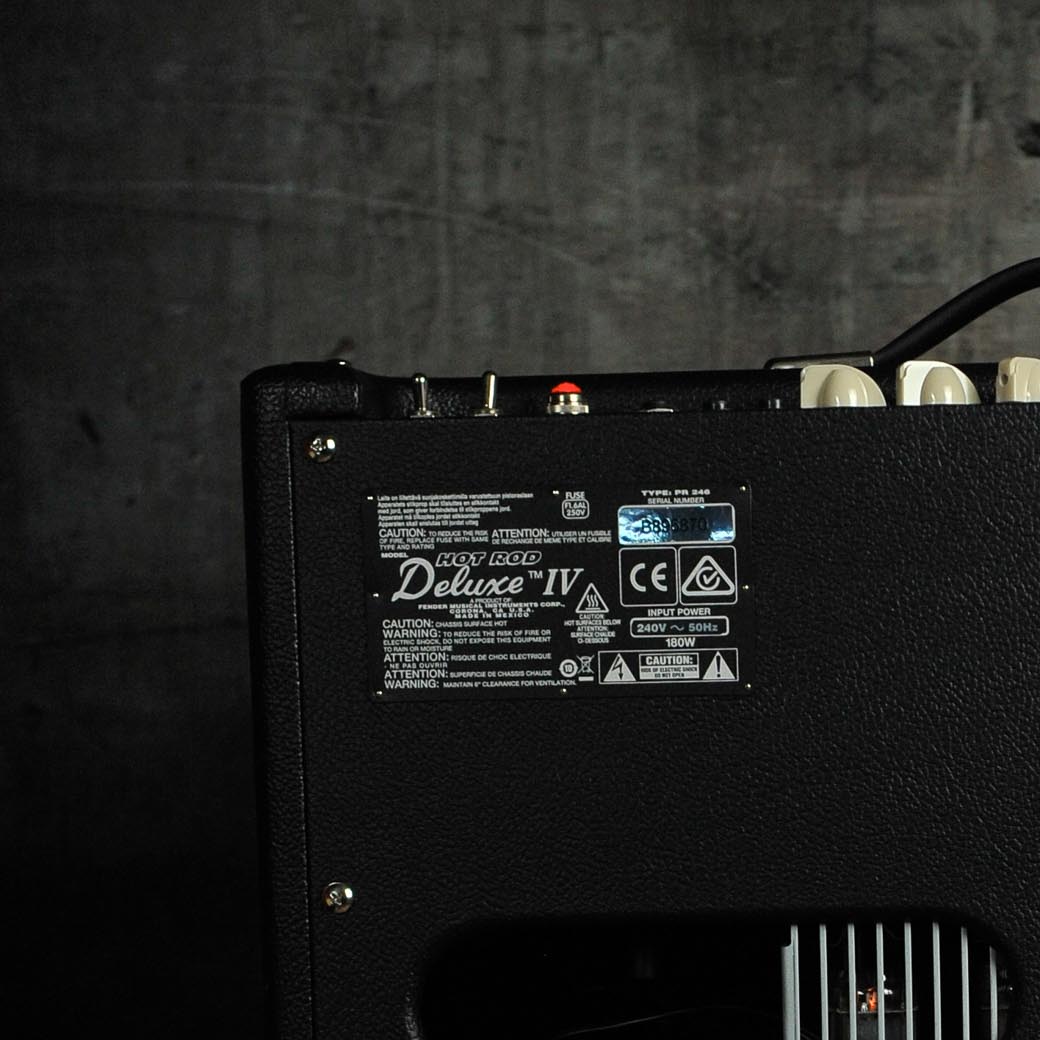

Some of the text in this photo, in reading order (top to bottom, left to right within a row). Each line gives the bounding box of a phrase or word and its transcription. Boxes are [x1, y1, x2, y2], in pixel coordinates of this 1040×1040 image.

[565, 492, 585, 500] FUSE
[379, 528, 426, 538] CAUTION:
[491, 528, 550, 538] ATTENTION:
[435, 550, 542, 567] HOT ROD
[391, 557, 524, 602] Deluxe
[542, 568, 584, 596] IV
[629, 562, 668, 592] CE
[648, 608, 711, 617] INPUT POWER
[382, 619, 434, 629] CAUTION:
[637, 623, 718, 633] 240V 50Hz
[382, 629, 442, 638] WARNING:
[666, 638, 696, 648] 180W
[383, 652, 449, 663] ATTENTION:
[645, 656, 693, 665] CAUTION:
[384, 669, 449, 679] ATTENTION:
[384, 679, 440, 689] WARNING:
